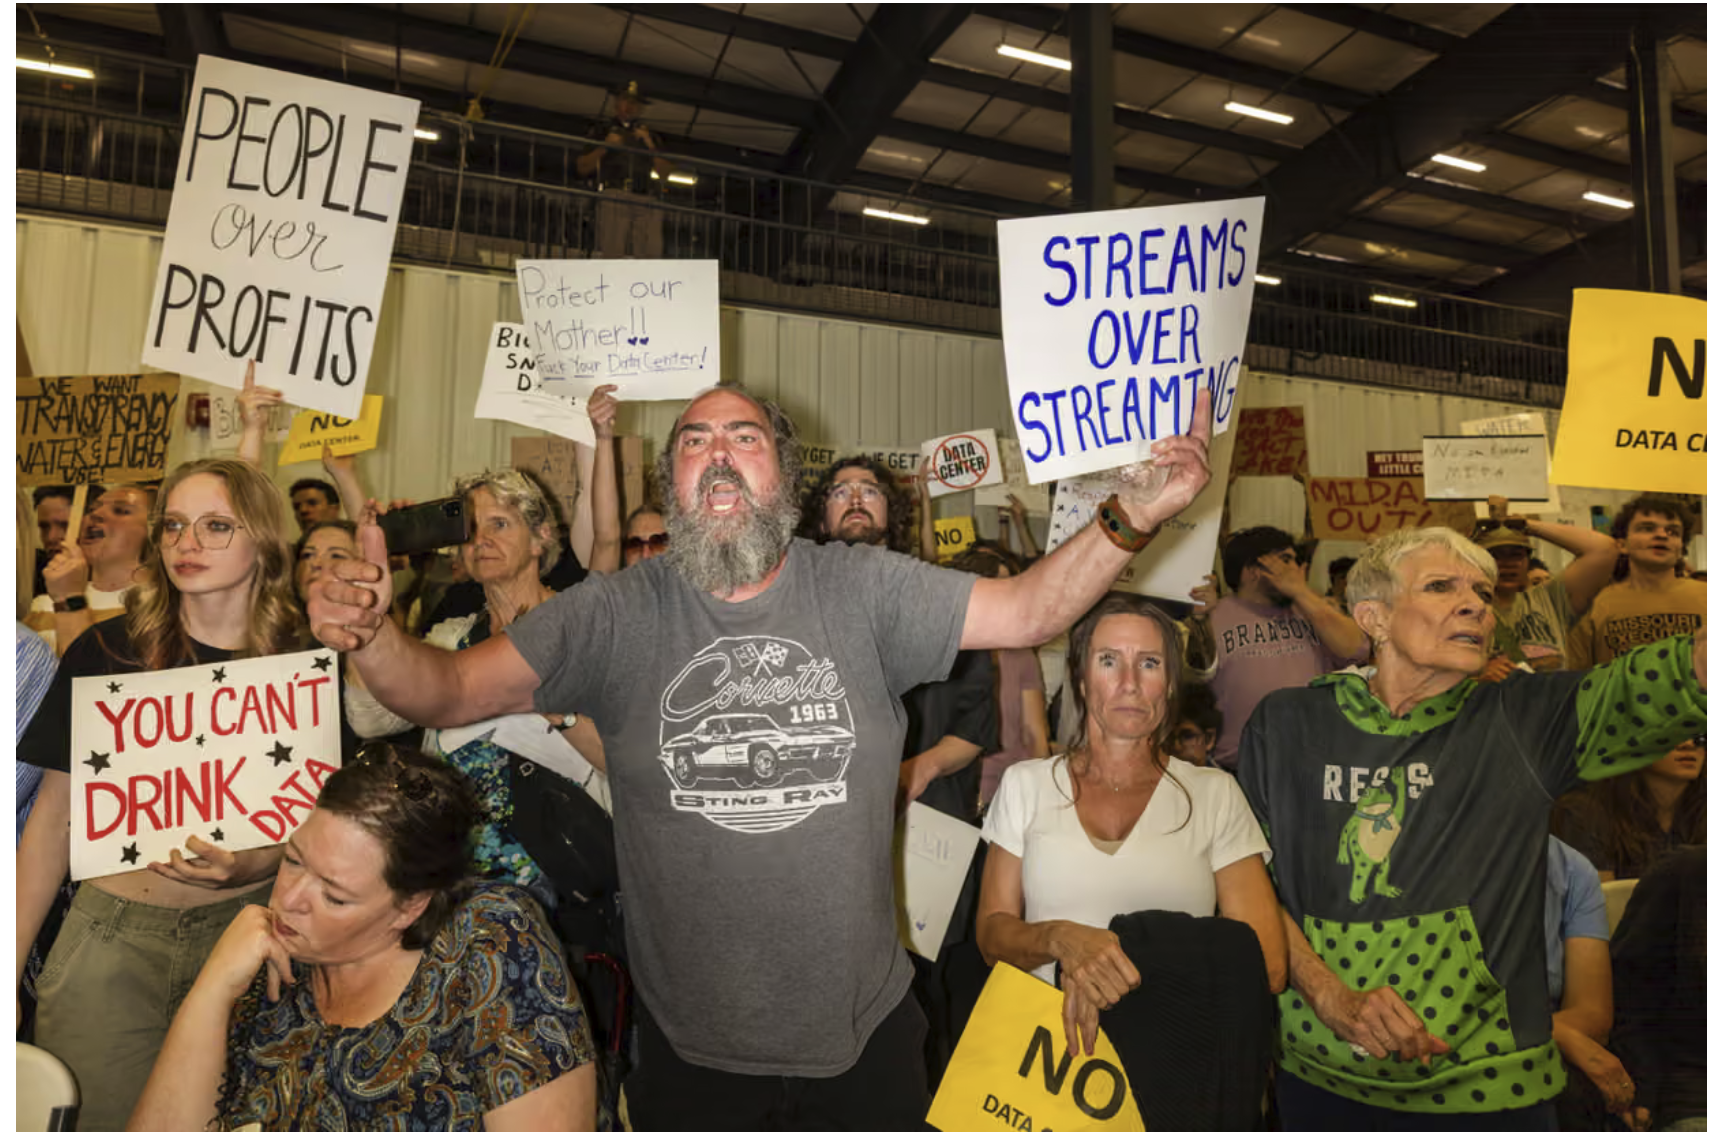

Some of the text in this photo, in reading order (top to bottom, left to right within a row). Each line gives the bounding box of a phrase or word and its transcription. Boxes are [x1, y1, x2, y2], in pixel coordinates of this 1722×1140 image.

[186, 87, 402, 222] PEOPLE
[211, 203, 343, 272] over
[1043, 218, 1247, 306] STREAMS
[521, 266, 682, 309] Protect our
[154, 263, 373, 387] PROFITS
[1088, 304, 1201, 369] OVER
[39, 375, 144, 396] WE WANT
[1648, 336, 1706, 399] N
[1019, 356, 1239, 463] STREAMING
[889, 452, 920, 470] GET
[943, 441, 976, 463] DATA
[1615, 428, 1678, 450] DATA
[939, 456, 986, 480] CENTER
[935, 528, 962, 546] NO
[1222, 618, 1320, 654] BRANSON
[1607, 614, 1699, 633] MISSOURI
[95, 673, 330, 753] YOU CAN'T
[661, 653, 845, 722] Corvette
[790, 703, 839, 723] 1963
[85, 756, 248, 841] DRINK
[248, 758, 341, 843] DATA
[674, 786, 845, 807] STING RAY
[1018, 1025, 1126, 1121] NO
[982, 1094, 1033, 1132] DATA
